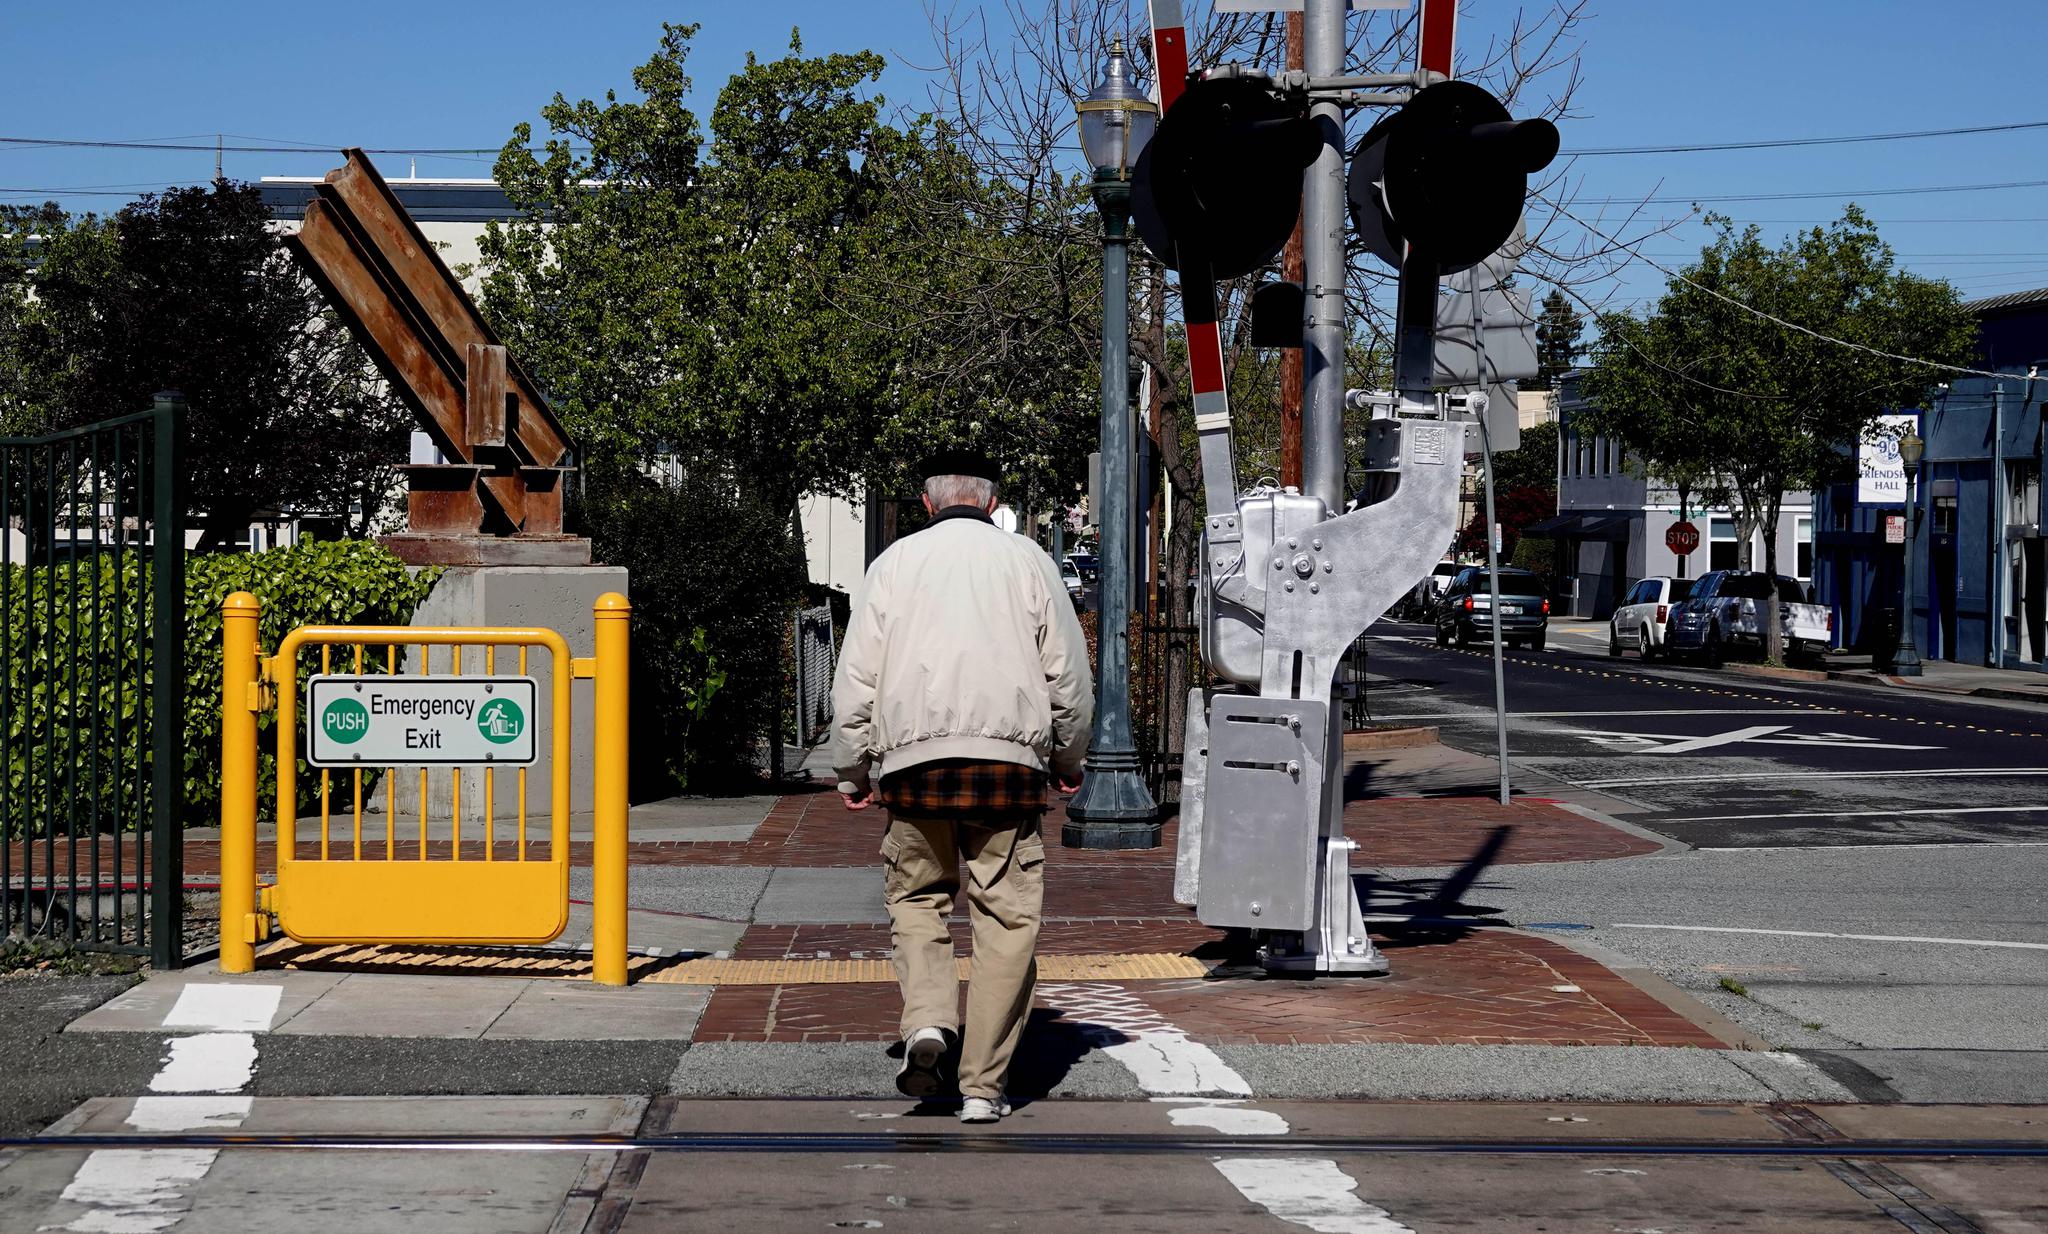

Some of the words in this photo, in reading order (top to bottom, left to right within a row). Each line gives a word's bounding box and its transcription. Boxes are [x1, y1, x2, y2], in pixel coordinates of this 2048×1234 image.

[1861, 470, 1907, 479] FRIENDSH
[1875, 482, 1900, 490] HALL
[1668, 532, 1698, 545] STOP
[371, 694, 475, 720] Emergency
[326, 712, 366, 730] PUSH
[405, 728, 442, 749] Exit
